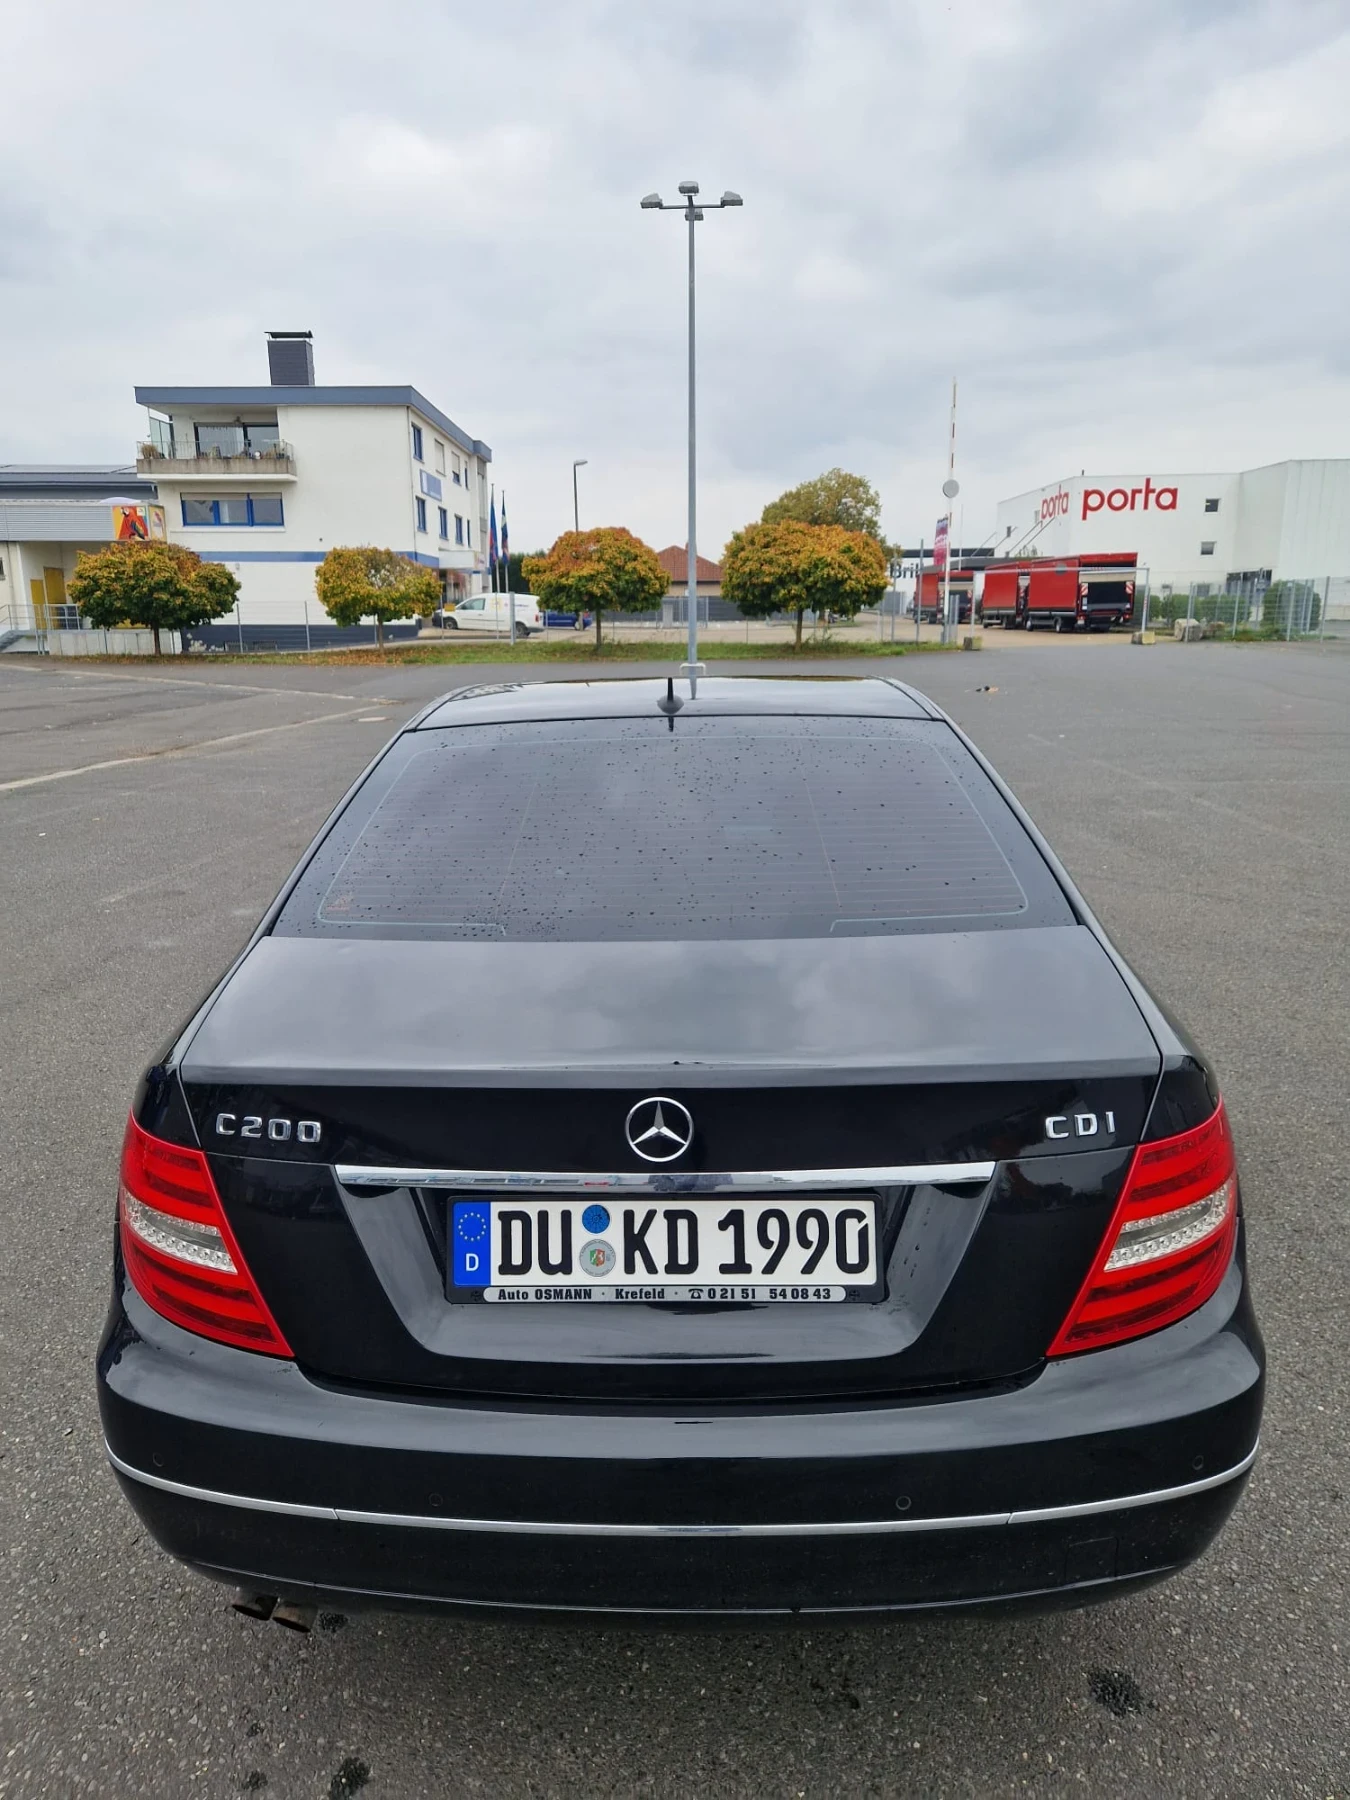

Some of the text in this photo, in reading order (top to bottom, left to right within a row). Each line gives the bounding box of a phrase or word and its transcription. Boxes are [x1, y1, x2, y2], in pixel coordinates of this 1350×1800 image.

[1041, 484, 1069, 520] porta
[1082, 477, 1178, 521] porta
[215, 1113, 322, 1143] C200
[1045, 1111, 1116, 1139] CDI
[498, 1209, 573, 1275] DU
[623, 1209, 699, 1275] KD
[717, 1208, 870, 1275] 1990
[465, 1253, 480, 1272] D
[498, 1288, 529, 1300] Auto
[534, 1288, 592, 1300] OSMANN
[615, 1288, 665, 1300] Krefeld
